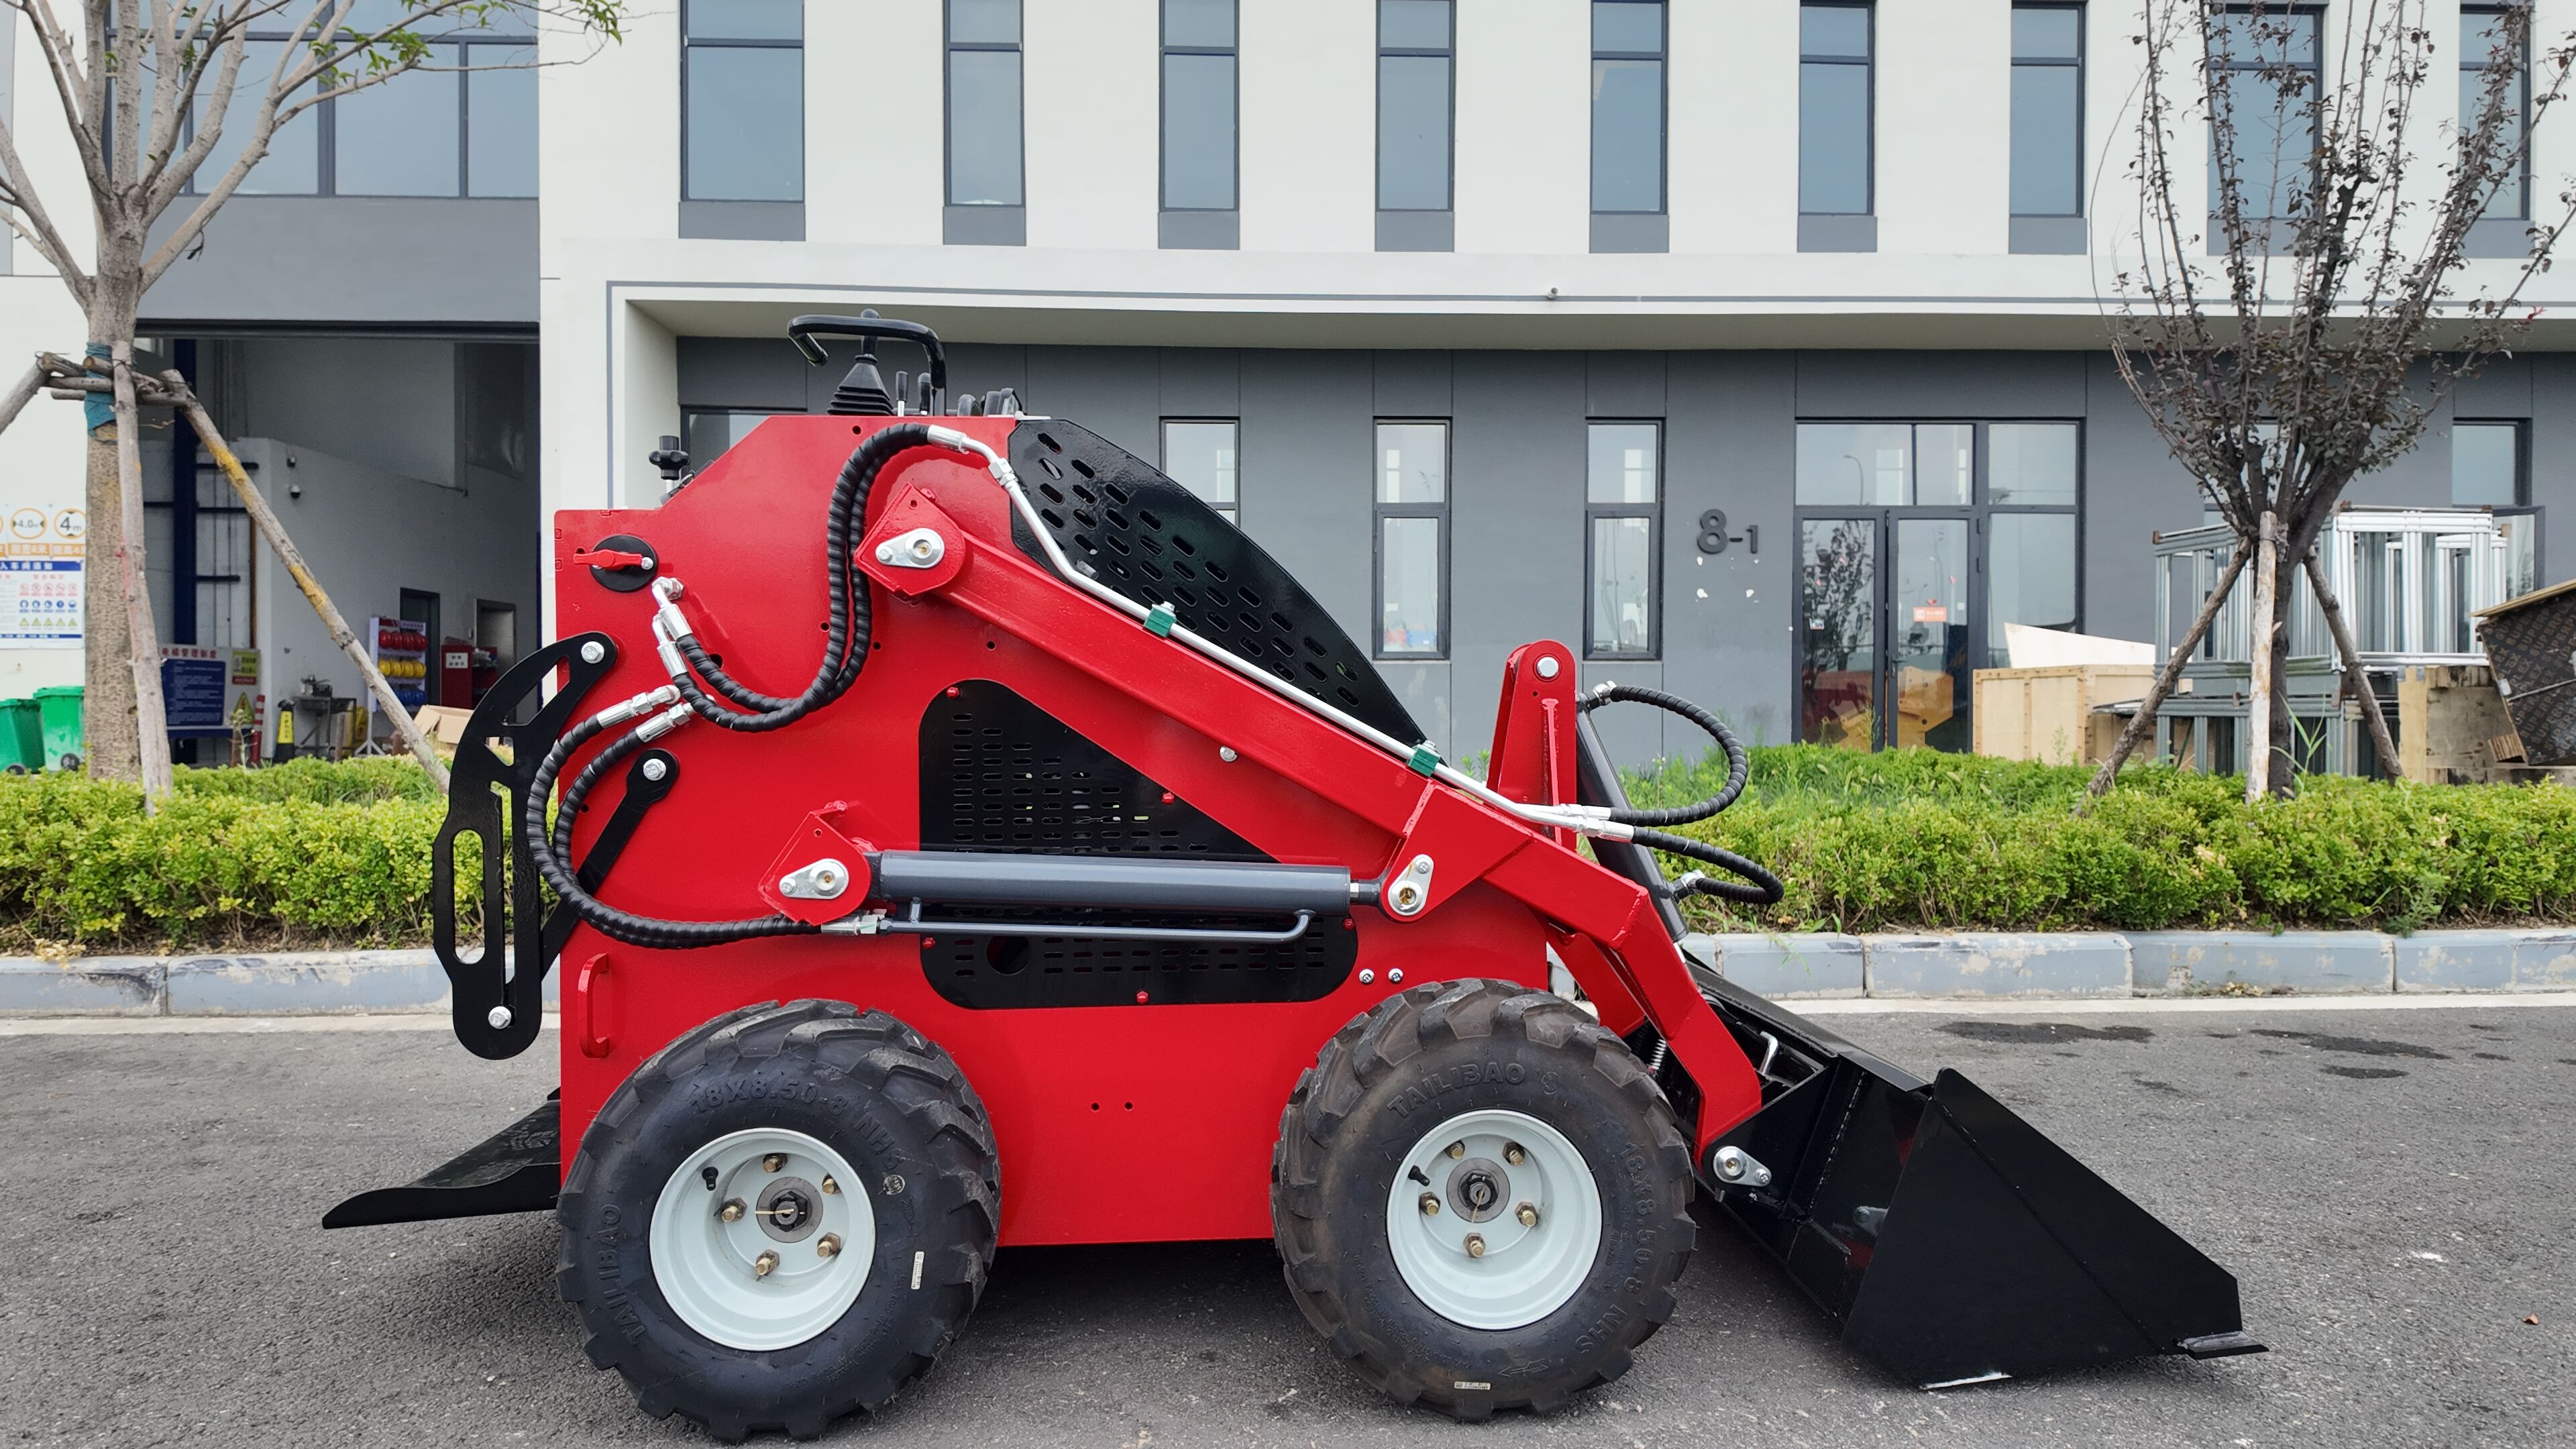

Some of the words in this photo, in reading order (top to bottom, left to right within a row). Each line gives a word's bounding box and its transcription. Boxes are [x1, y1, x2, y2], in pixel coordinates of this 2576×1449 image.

[1697, 508, 1758, 555] 8-1
[690, 1077, 849, 1116] 18X8.50-8
[853, 1112, 905, 1172] NHS
[1387, 1061, 1525, 1118] TAILIBAO
[1619, 1142, 1657, 1295] 18X8.50-8
[597, 1203, 646, 1348] TAILIBAO
[1575, 1303, 1628, 1354] NHS
